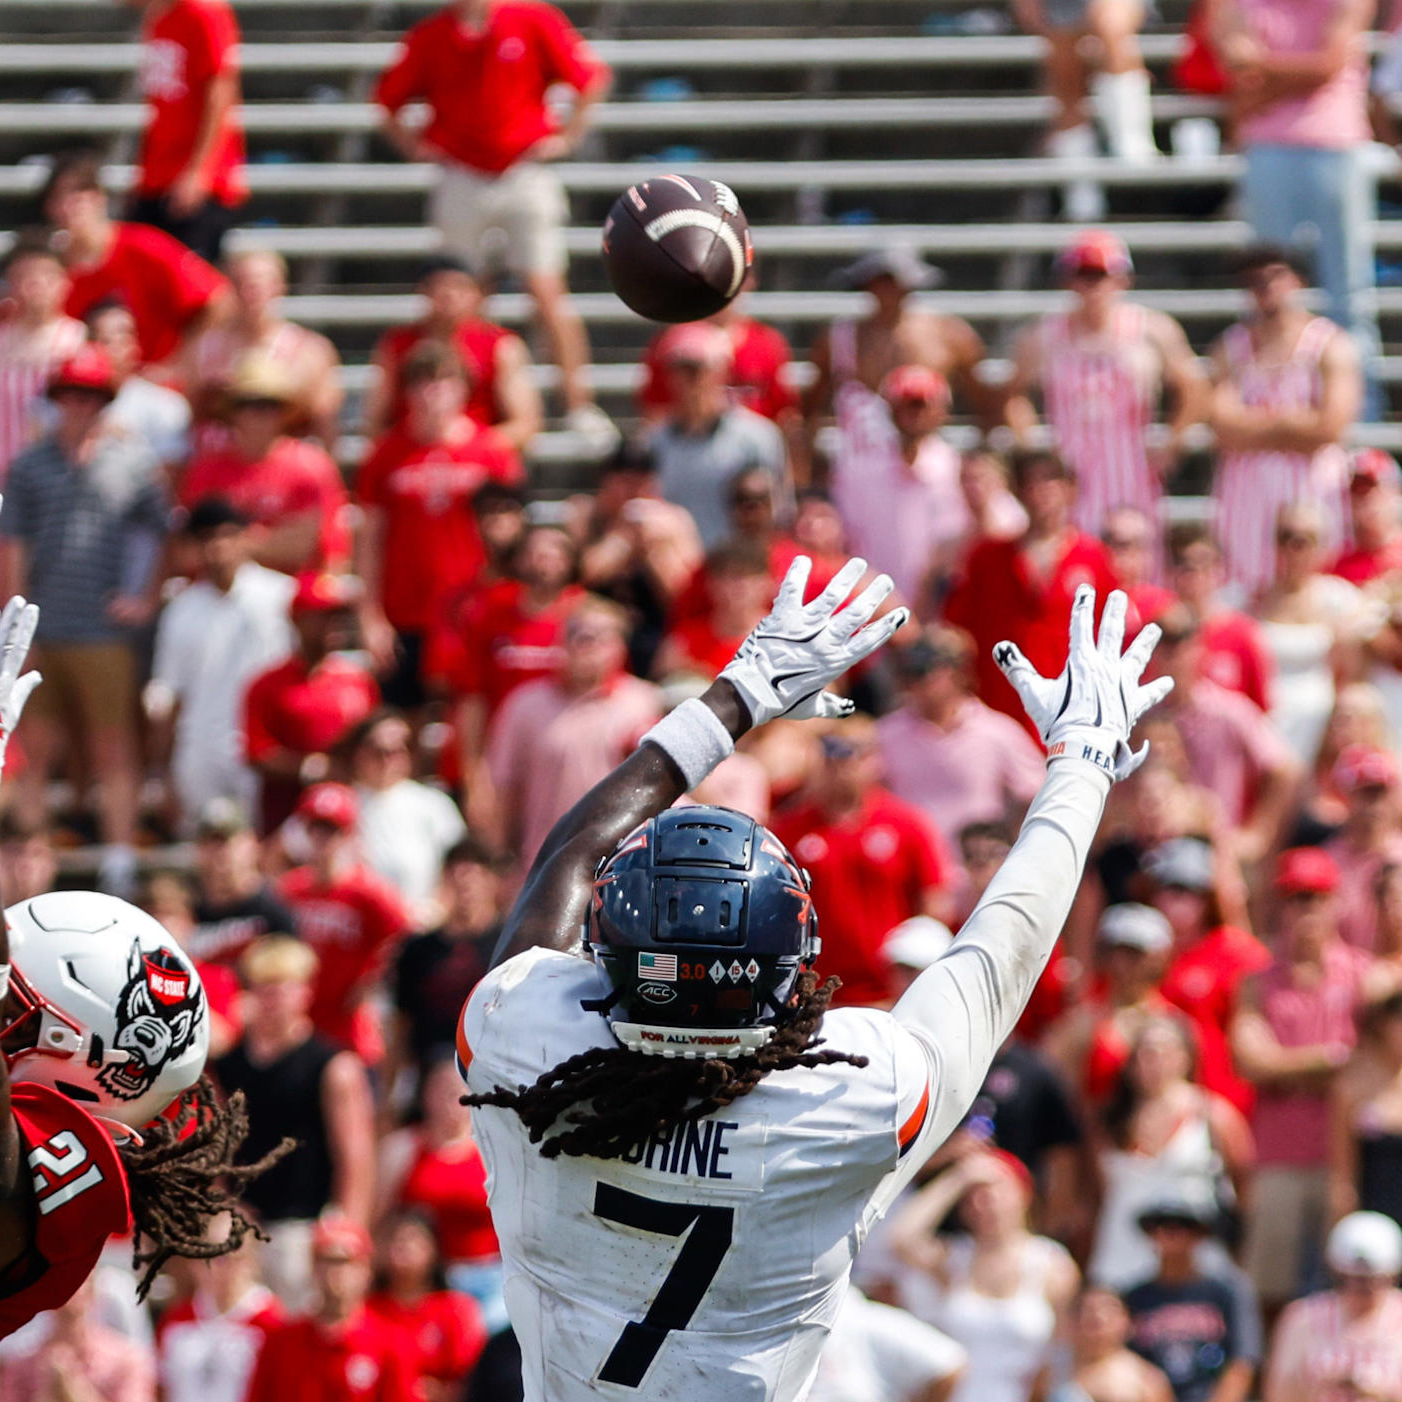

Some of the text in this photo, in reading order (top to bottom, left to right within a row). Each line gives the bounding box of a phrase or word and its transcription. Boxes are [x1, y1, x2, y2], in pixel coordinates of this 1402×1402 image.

[679, 963, 706, 980] 3.0
[731, 965, 741, 976] 15
[150, 973, 185, 997] NC STATE
[643, 986, 671, 997] ACC
[689, 1004, 699, 1016] 7
[640, 1031, 664, 1042] FOR
[27, 1130, 104, 1216] 21
[593, 1180, 735, 1389] 7
